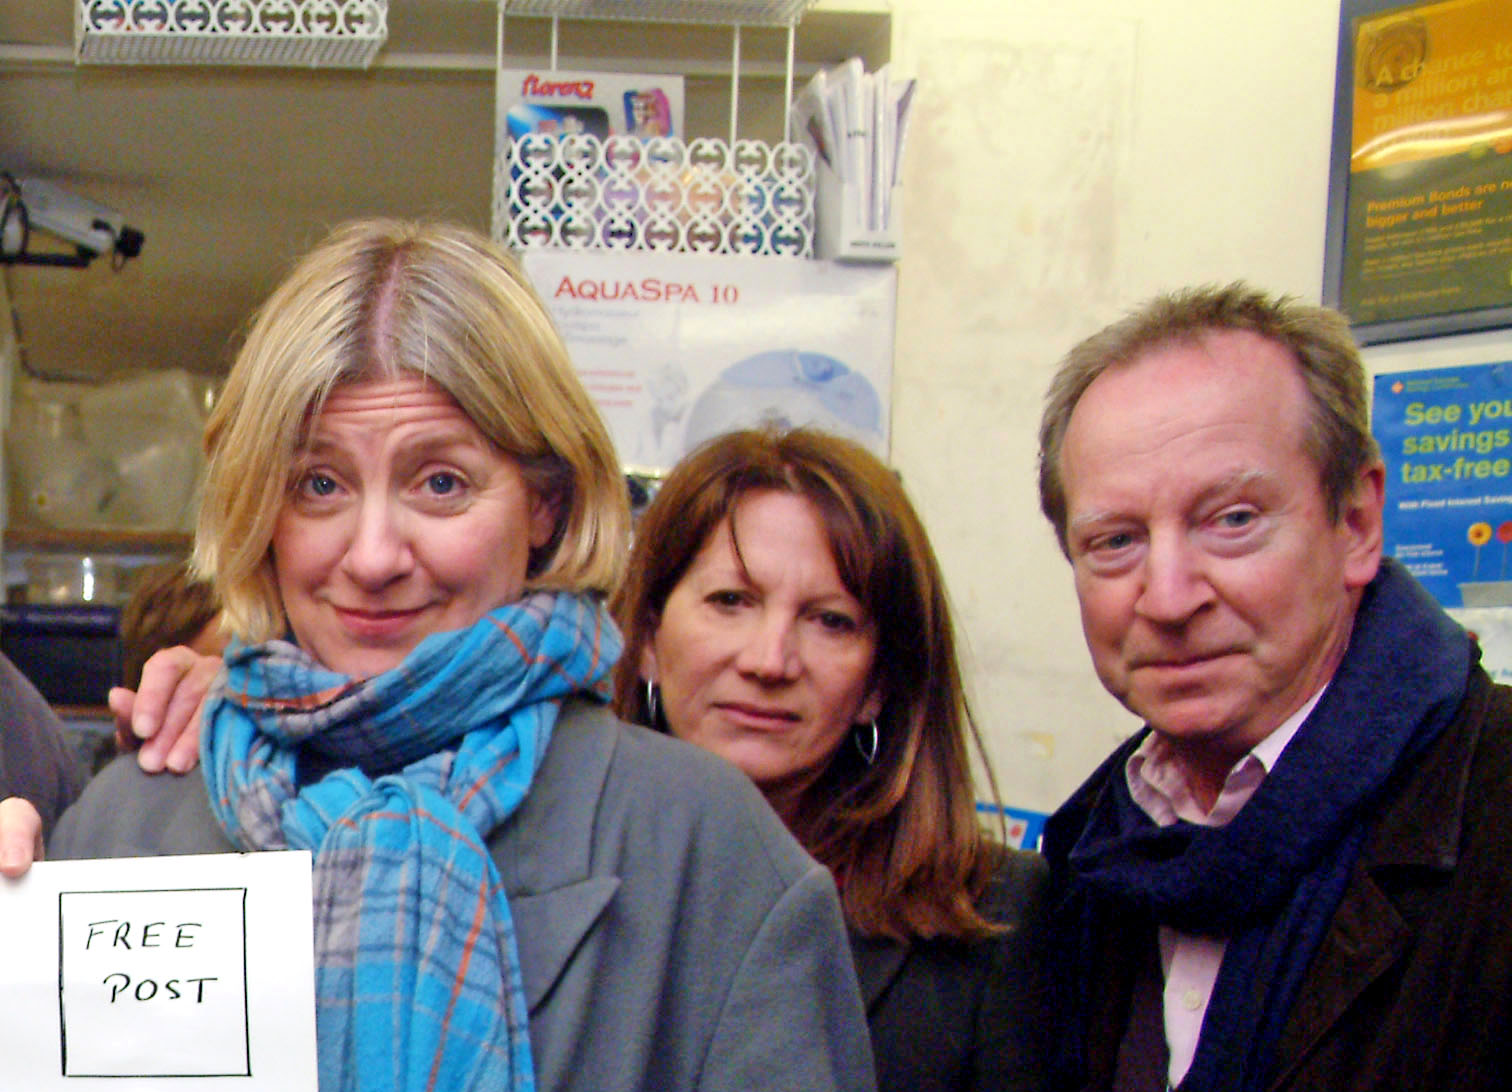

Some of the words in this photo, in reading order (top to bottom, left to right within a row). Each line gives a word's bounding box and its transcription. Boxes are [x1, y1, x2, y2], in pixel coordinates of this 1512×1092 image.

[1396, 74, 1477, 105] million
[1367, 196, 1426, 211] Premium
[1429, 185, 1471, 203] Bonds
[1474, 183, 1497, 195] are
[1367, 213, 1408, 229] bigger
[1412, 204, 1438, 220] and
[1441, 200, 1484, 216] better
[712, 283, 740, 304] 10
[1404, 401, 1462, 426] See
[1469, 399, 1512, 426] you
[1403, 428, 1511, 455] savings
[1401, 457, 1511, 484] tax-free
[85, 920, 202, 950] FREE
[102, 972, 218, 1004] POST
